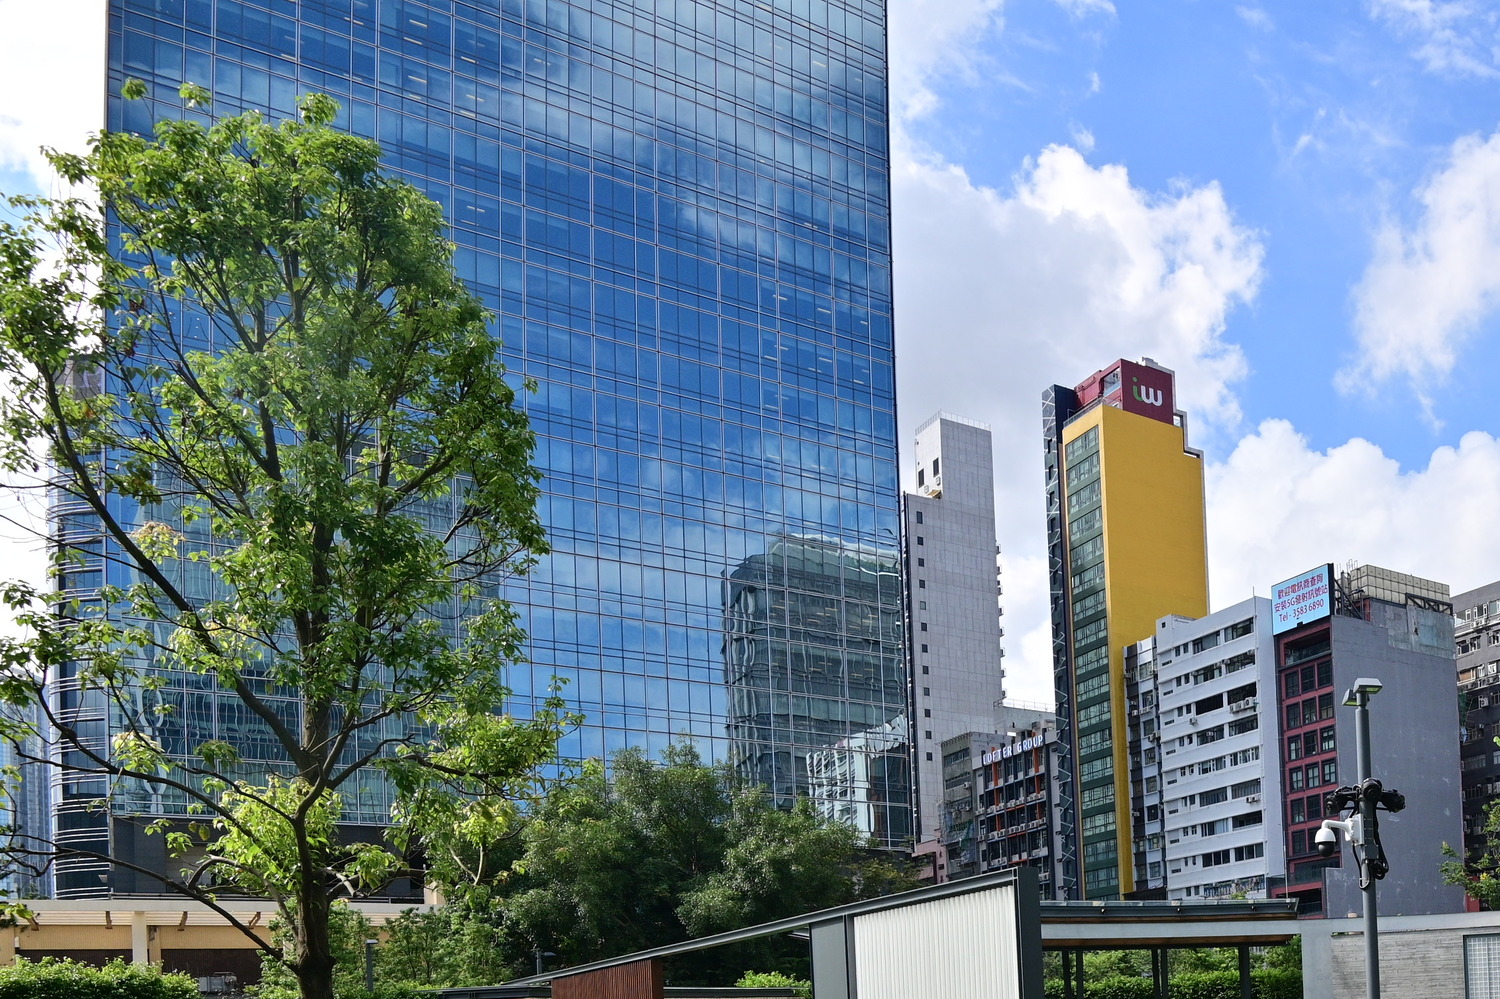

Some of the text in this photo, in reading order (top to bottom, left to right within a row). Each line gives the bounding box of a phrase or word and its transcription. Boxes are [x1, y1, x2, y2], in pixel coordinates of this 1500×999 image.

[1279, 611, 1289, 622] Tel
[983, 734, 1044, 765] LOFTER GROUP
